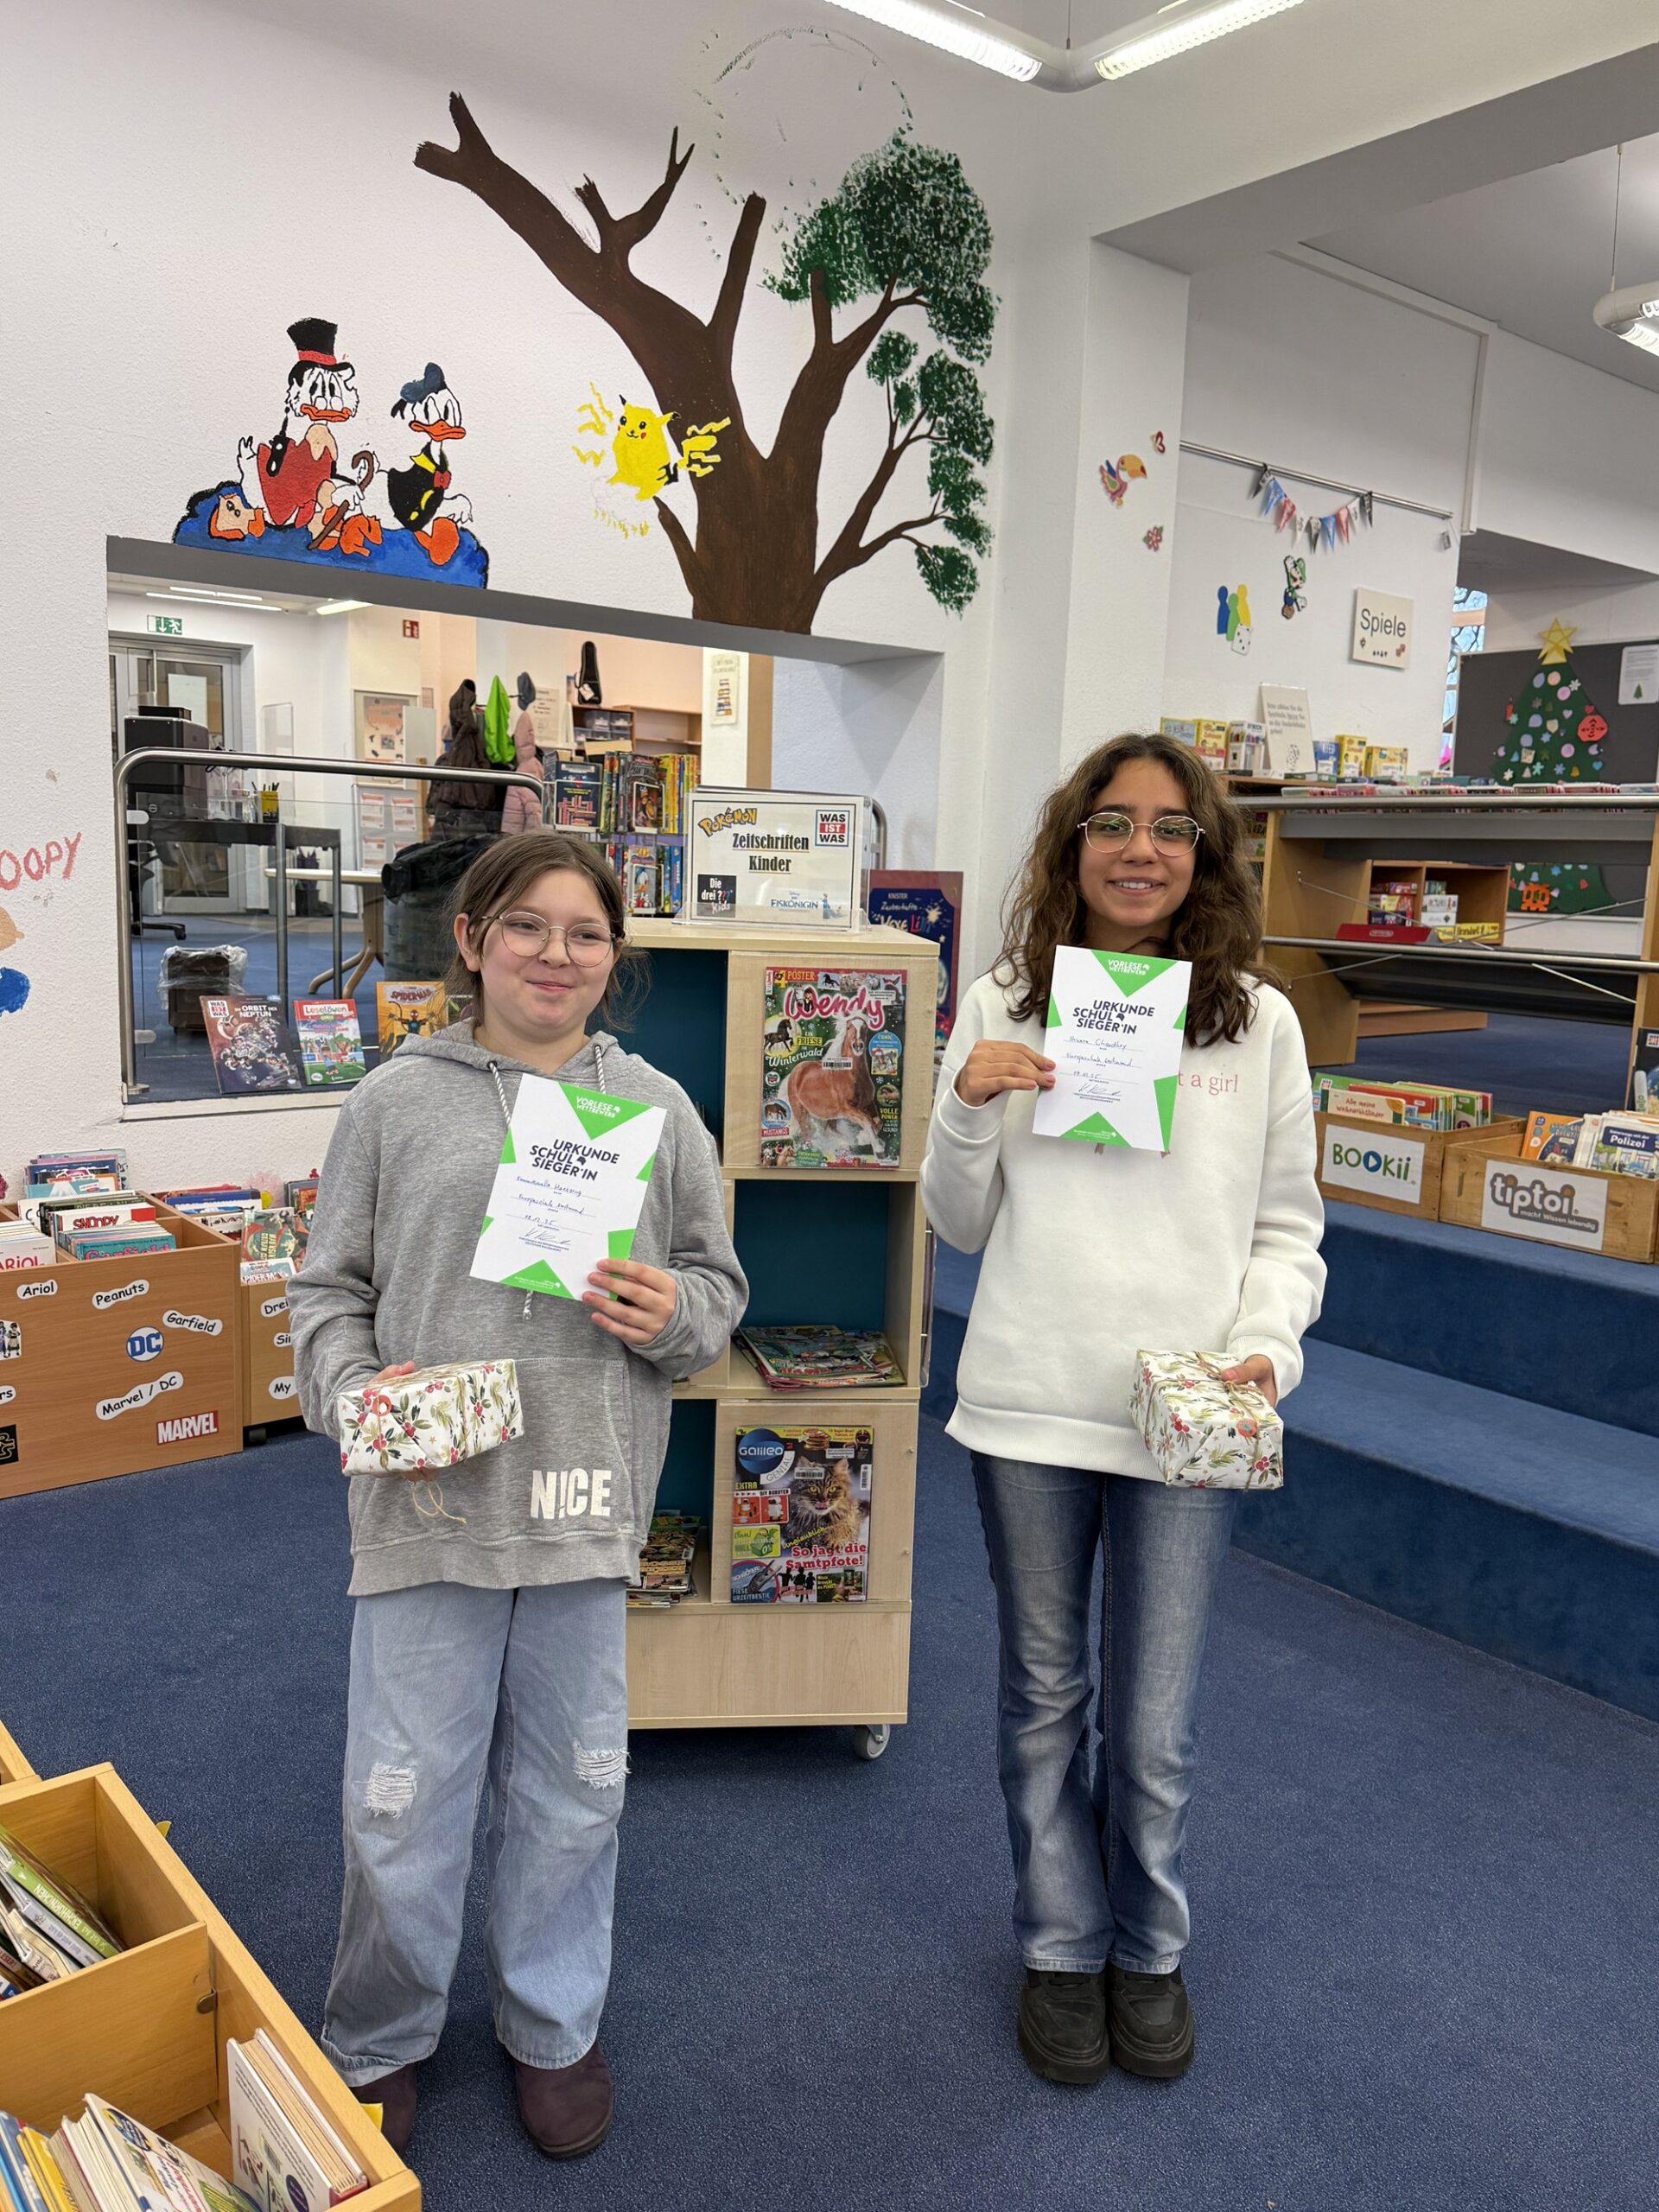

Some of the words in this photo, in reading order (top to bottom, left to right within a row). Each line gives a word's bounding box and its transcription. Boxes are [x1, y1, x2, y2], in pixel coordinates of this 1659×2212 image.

[1360, 608, 1407, 638] Spiele
[698, 807, 757, 837] Pokémon
[824, 823, 842, 833] IST
[733, 833, 810, 850] Zeitschriften
[819, 834, 845, 843] WAS
[748, 855, 792, 872] Kinder
[709, 878, 721, 888] Die
[702, 890, 715, 900] drei
[1108, 959, 1142, 969] VORLESE
[787, 970, 815, 981] POSTER
[306, 1005, 347, 1014] Leselöwen
[784, 985, 884, 1029] Wendy
[1072, 1007, 1113, 1021] SCHUL
[1092, 1000, 1155, 1017] URKUNDE
[766, 1048, 823, 1067] Winterwald
[1209, 1072, 1238, 1096] girl
[576, 1096, 613, 1112] VORLESE
[1610, 1135, 1645, 1148] Polizei
[530, 1145, 573, 1163] SCHUL
[553, 1139, 620, 1164] URKUNDE
[1492, 1174, 1573, 1215] tiptoi
[1520, 1210, 1541, 1218] macht
[1543, 1212, 1567, 1223] Wissen
[1567, 1218, 1596, 1230] lebendig
[22, 1282, 54, 1297] Ariol
[96, 1283, 145, 1306] Peanuts
[264, 1299, 289, 1314] Drei
[167, 1313, 216, 1332] Garfield
[129, 1332, 162, 1357] DC
[102, 1389, 143, 1415] Marvel
[160, 1376, 178, 1390] DC
[274, 1382, 291, 1394] My
[157, 1412, 218, 1444] MARVEL
[766, 1457, 793, 1482] GENIAL
[735, 1482, 758, 1491] EXTRA
[792, 1547, 810, 1558] So
[812, 1546, 841, 1558] jagt
[845, 1543, 867, 1554] die
[785, 1555, 863, 1570] Samtpfote!
